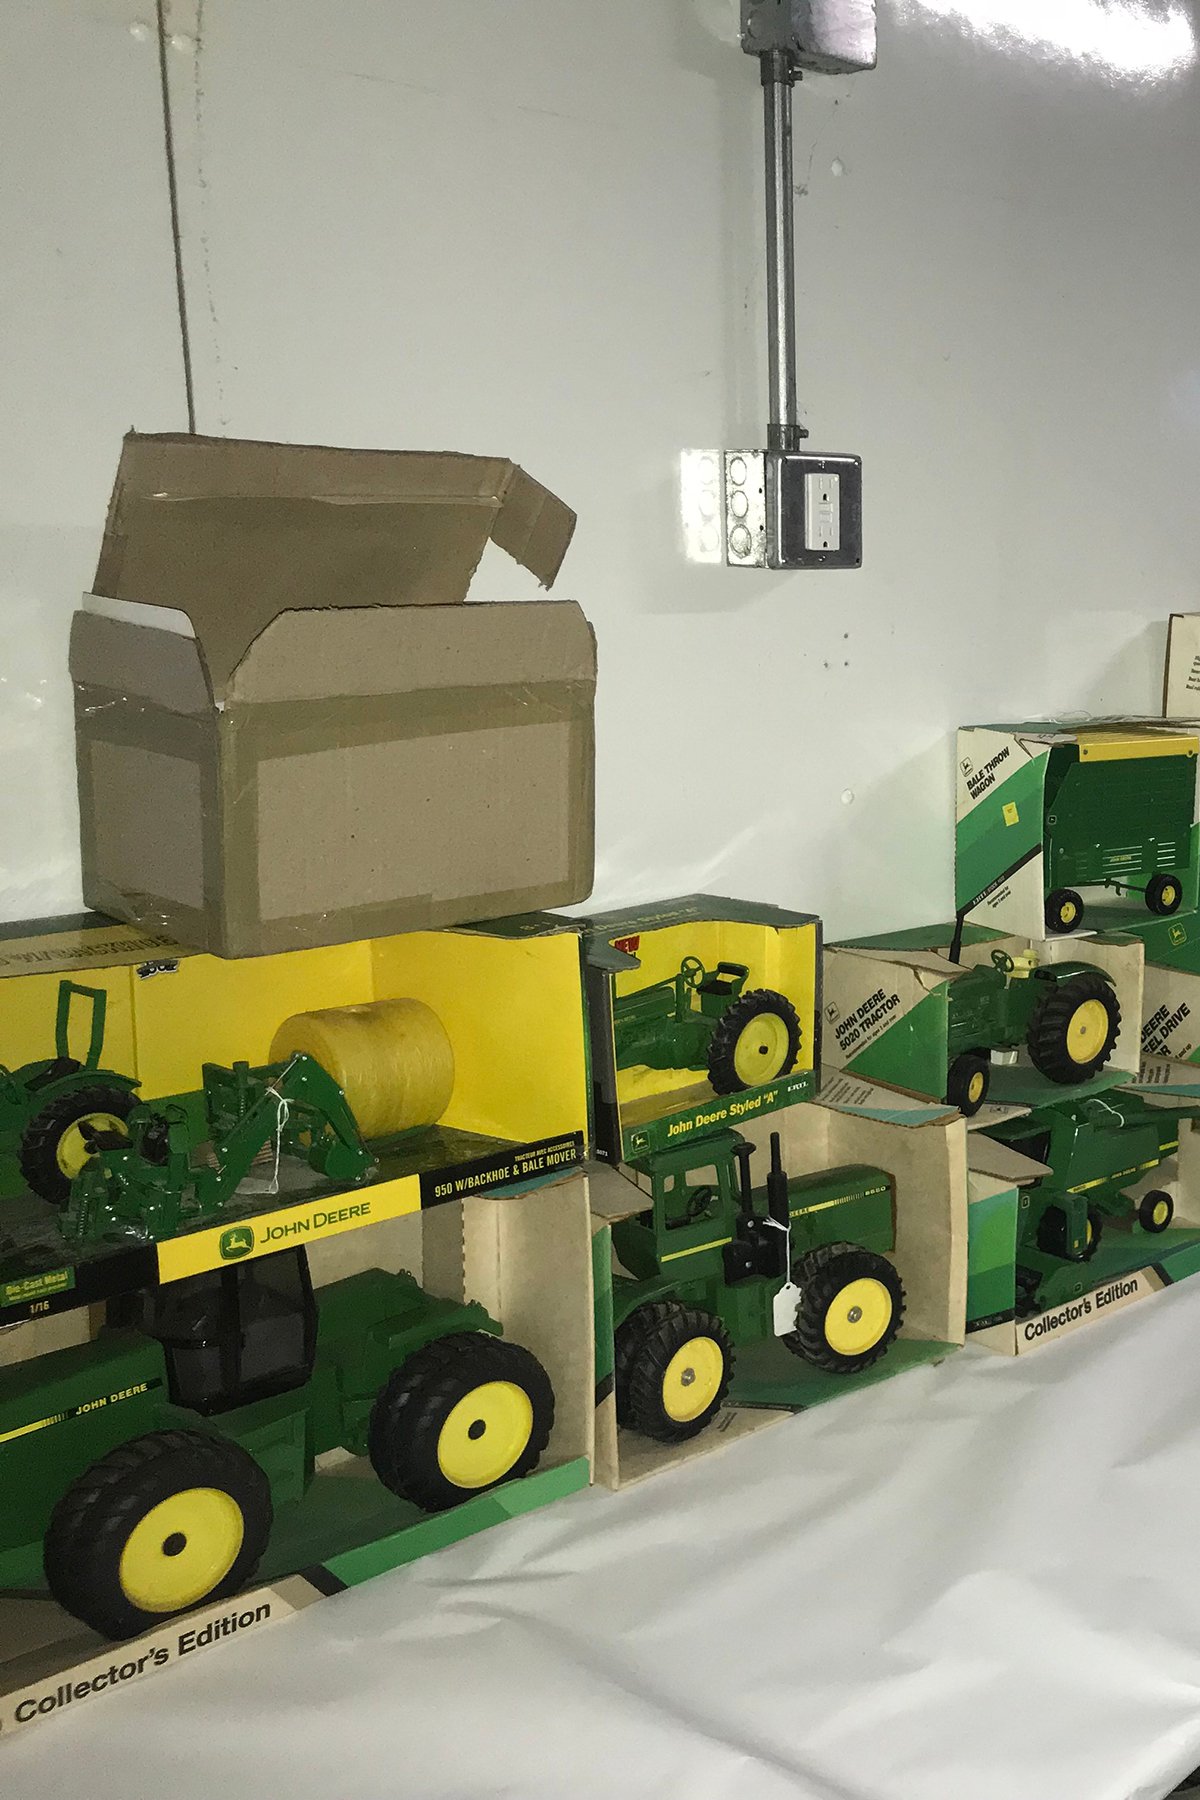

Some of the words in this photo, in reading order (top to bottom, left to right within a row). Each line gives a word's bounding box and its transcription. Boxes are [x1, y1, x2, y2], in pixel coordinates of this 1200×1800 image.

[966, 769, 985, 790] BALE
[984, 746, 1010, 774] THROW
[970, 772, 996, 800] WAGON
[835, 1013, 858, 1039] JOHN
[856, 988, 887, 1019] DEERE
[840, 1028, 861, 1050] 5020
[859, 994, 901, 1032] TRACTOR
[1141, 1004, 1171, 1043] DEERE
[1159, 1002, 1191, 1039] DRIVE
[667, 1121, 693, 1137] John
[695, 1109, 727, 1127] Deere
[729, 1095, 761, 1116] Styled
[763, 1089, 779, 1104] "A"
[434, 1182, 453, 1198] 950
[455, 1167, 510, 1191] W/BACKHOE
[512, 1166, 520, 1176] &
[522, 1157, 544, 1174] BALE
[547, 1148, 577, 1165] MOVER
[260, 1219, 310, 1244] JOHN
[313, 1202, 371, 1229] DEERE
[30, 1301, 50, 1314] 1/16
[1024, 1297, 1092, 1341] Collector's
[1096, 1278, 1139, 1309] Edition
[76, 1397, 107, 1415] JOHN
[110, 1382, 148, 1402] DEERE
[15, 1647, 170, 1724] Collector's
[178, 1602, 271, 1656] Edition
